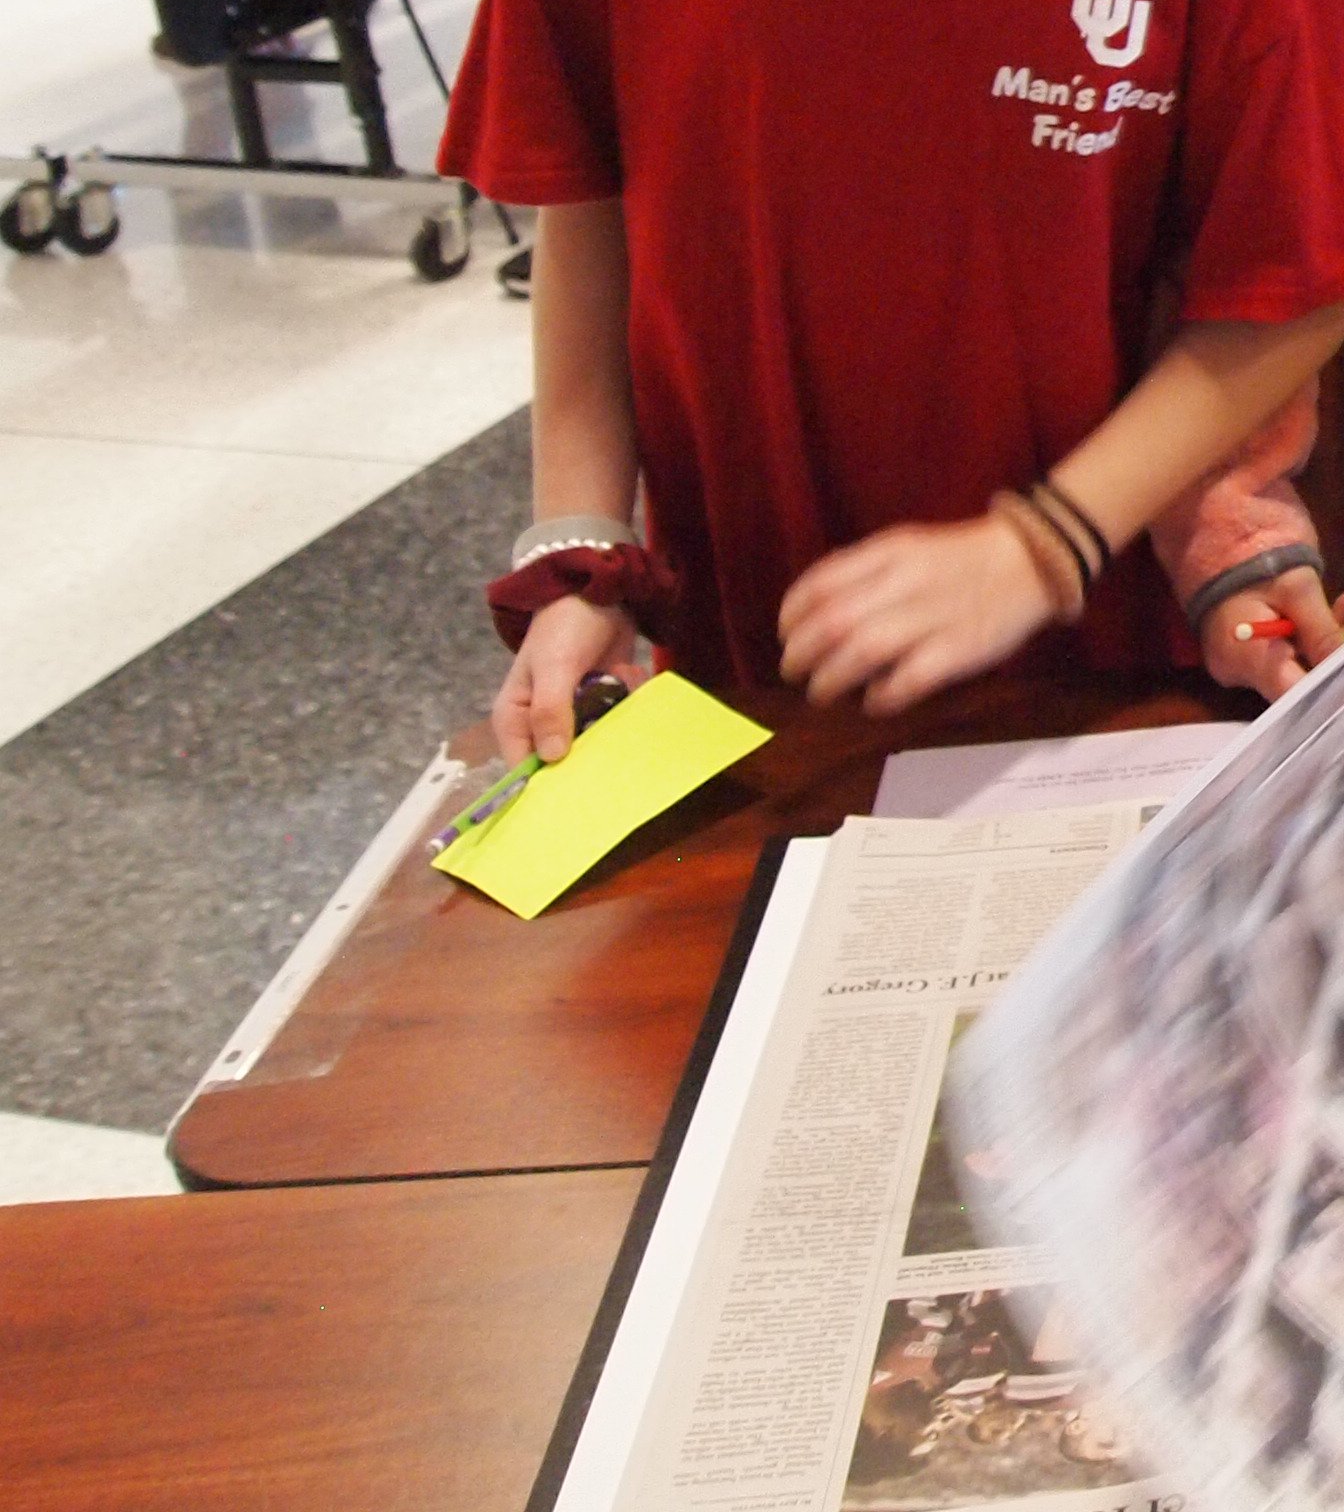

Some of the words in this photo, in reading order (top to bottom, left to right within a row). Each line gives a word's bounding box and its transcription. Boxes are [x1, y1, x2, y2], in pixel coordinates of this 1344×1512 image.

[990, 64, 1097, 112] Man's
[1103, 80, 1177, 115] Best
[820, 977, 930, 997] Gregory
